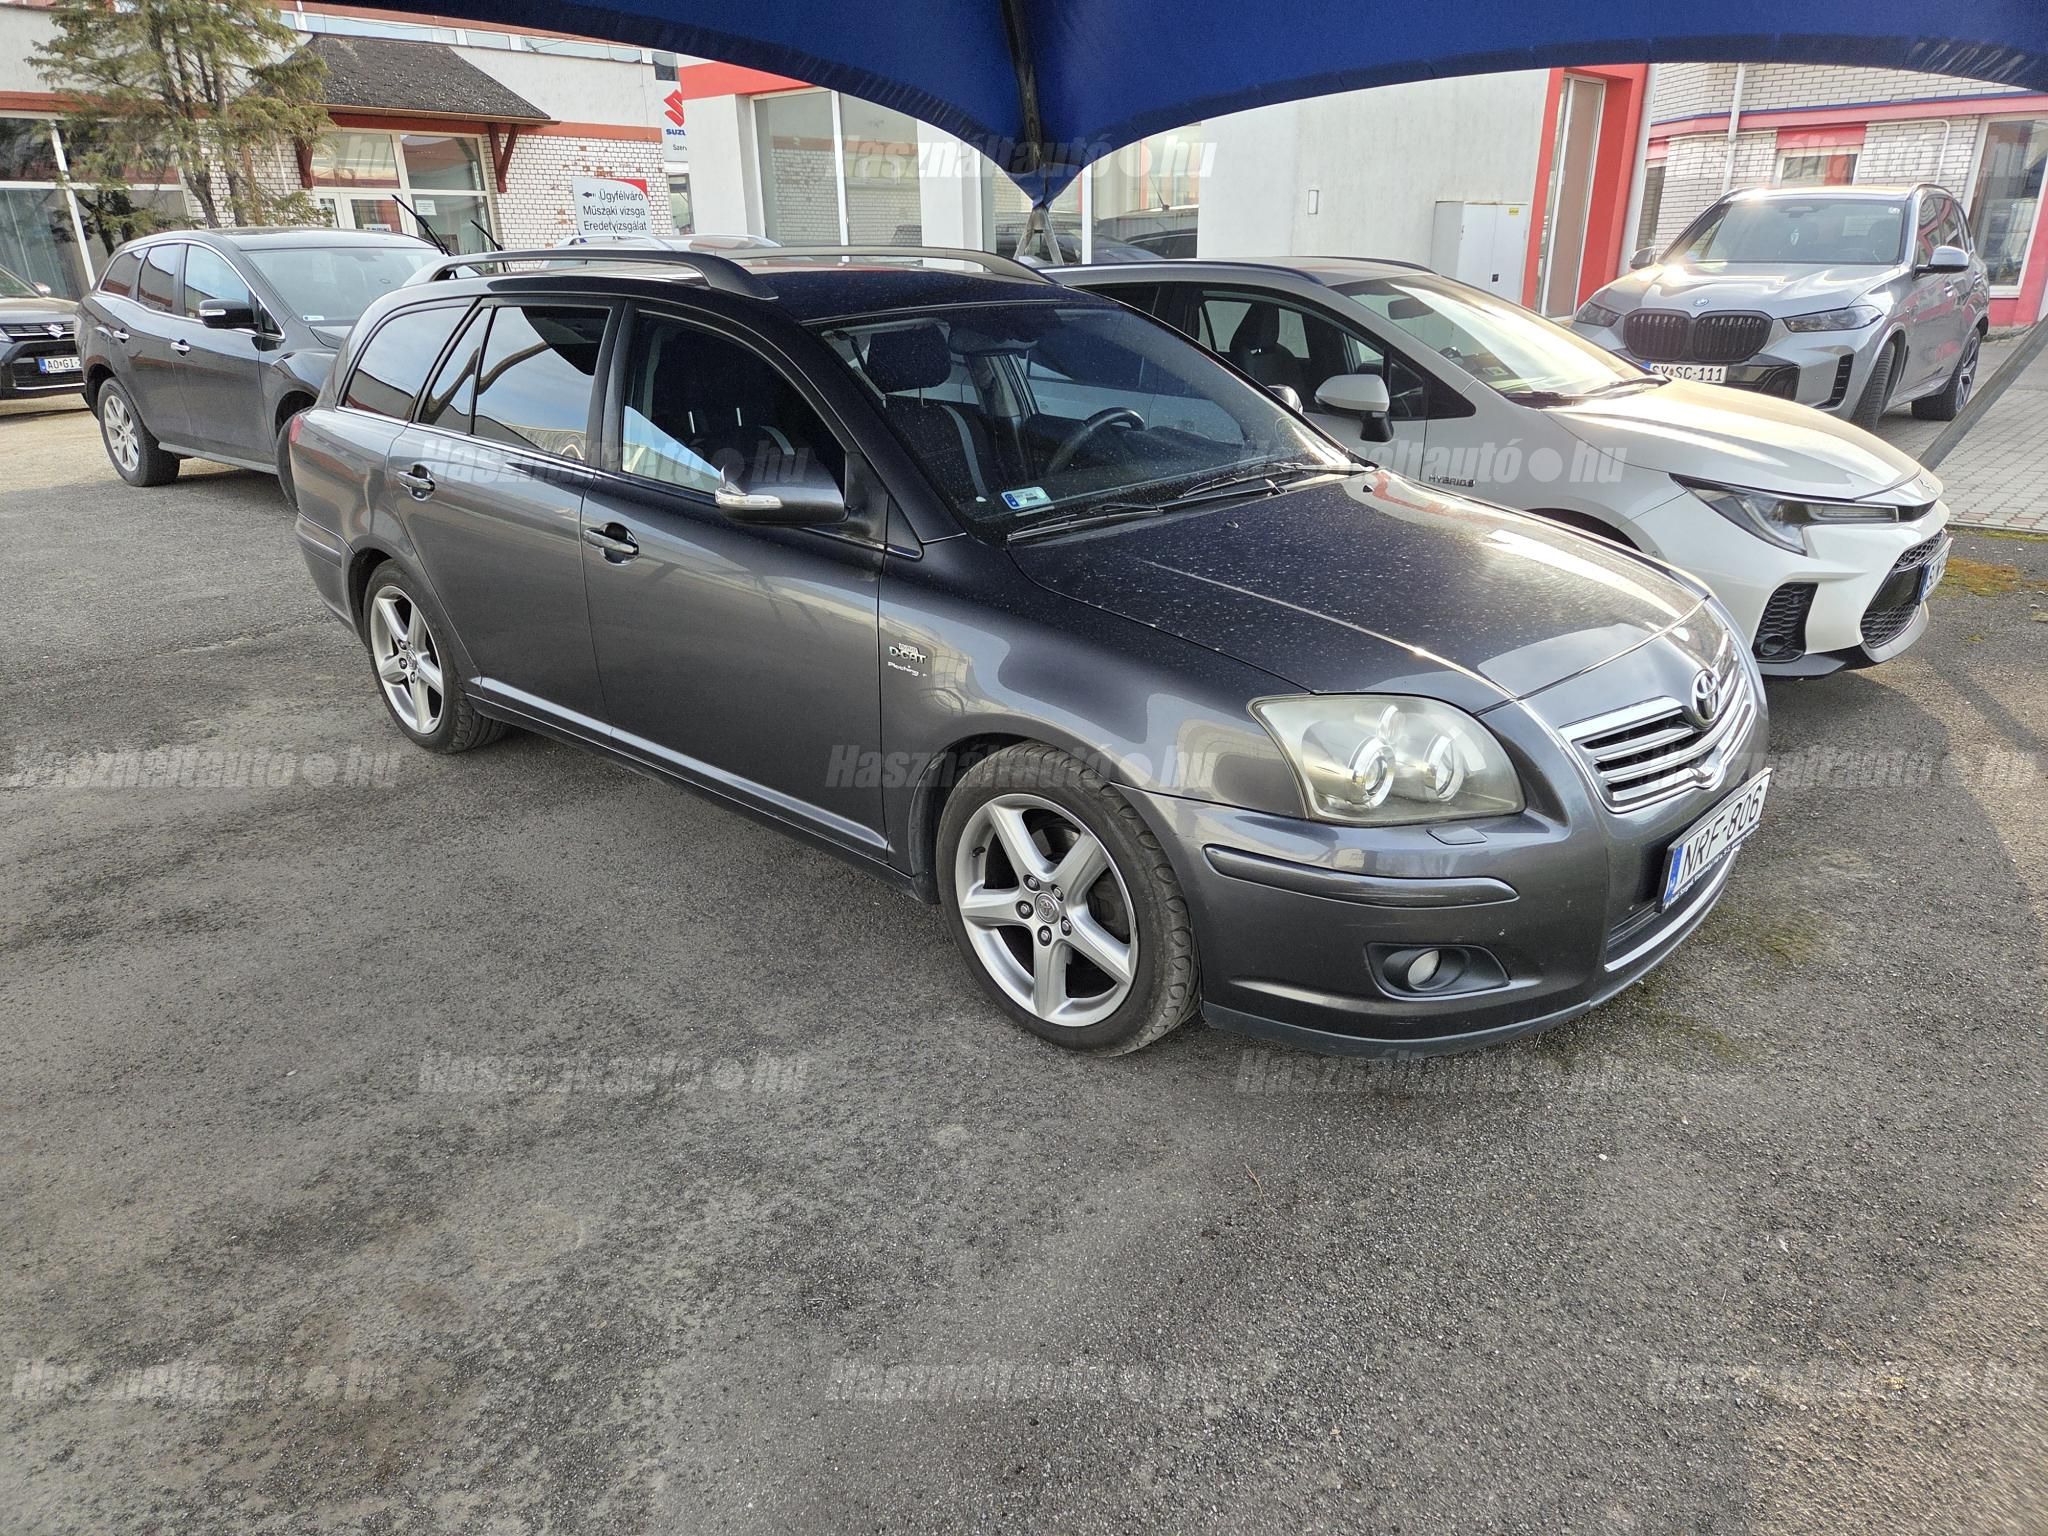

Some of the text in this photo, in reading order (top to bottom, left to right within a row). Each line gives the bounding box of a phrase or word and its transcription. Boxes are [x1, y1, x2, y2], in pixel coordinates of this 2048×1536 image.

[599, 189, 644, 203] Ügyfélváró
[619, 206, 646, 218] vizsga
[584, 219, 647, 233] Eredetvizsgálat
[1680, 784, 1763, 884] NRF-806
